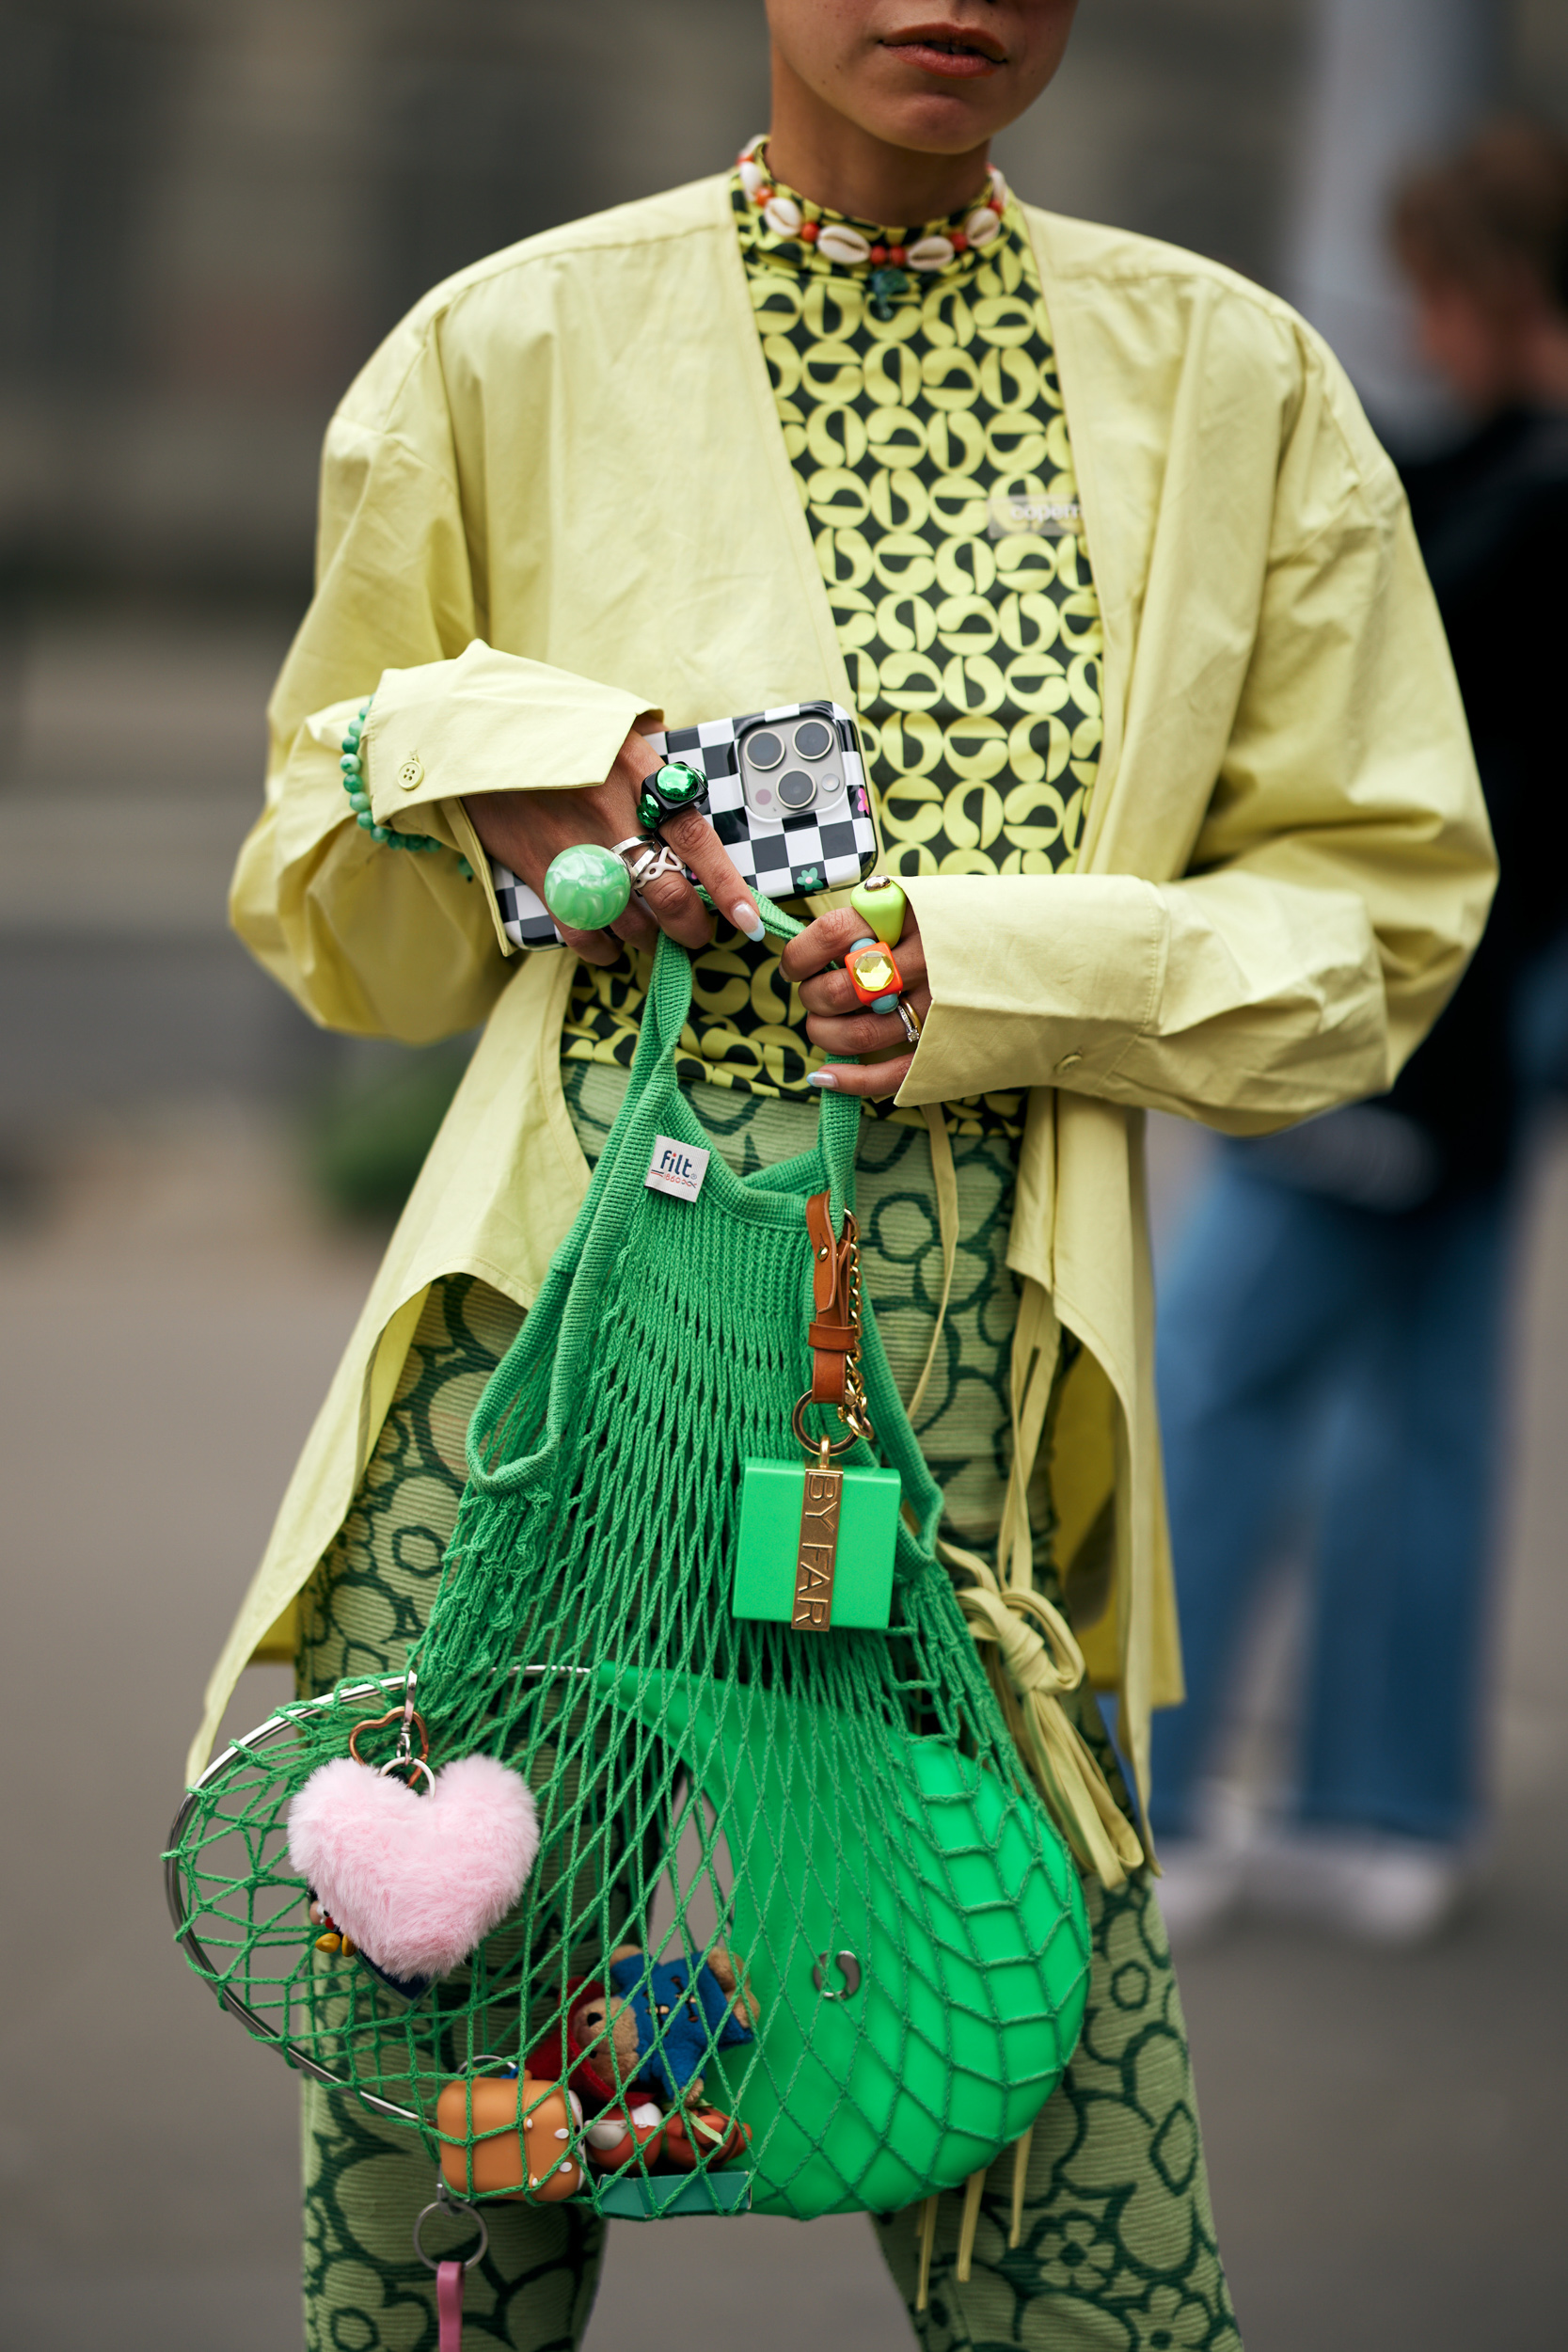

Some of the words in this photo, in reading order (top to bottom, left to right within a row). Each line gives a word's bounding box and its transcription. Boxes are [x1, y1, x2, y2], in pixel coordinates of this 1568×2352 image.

[660, 1150, 692, 1178] filt
[805, 1472, 840, 1533] BY
[795, 1543, 833, 1627] FAR
